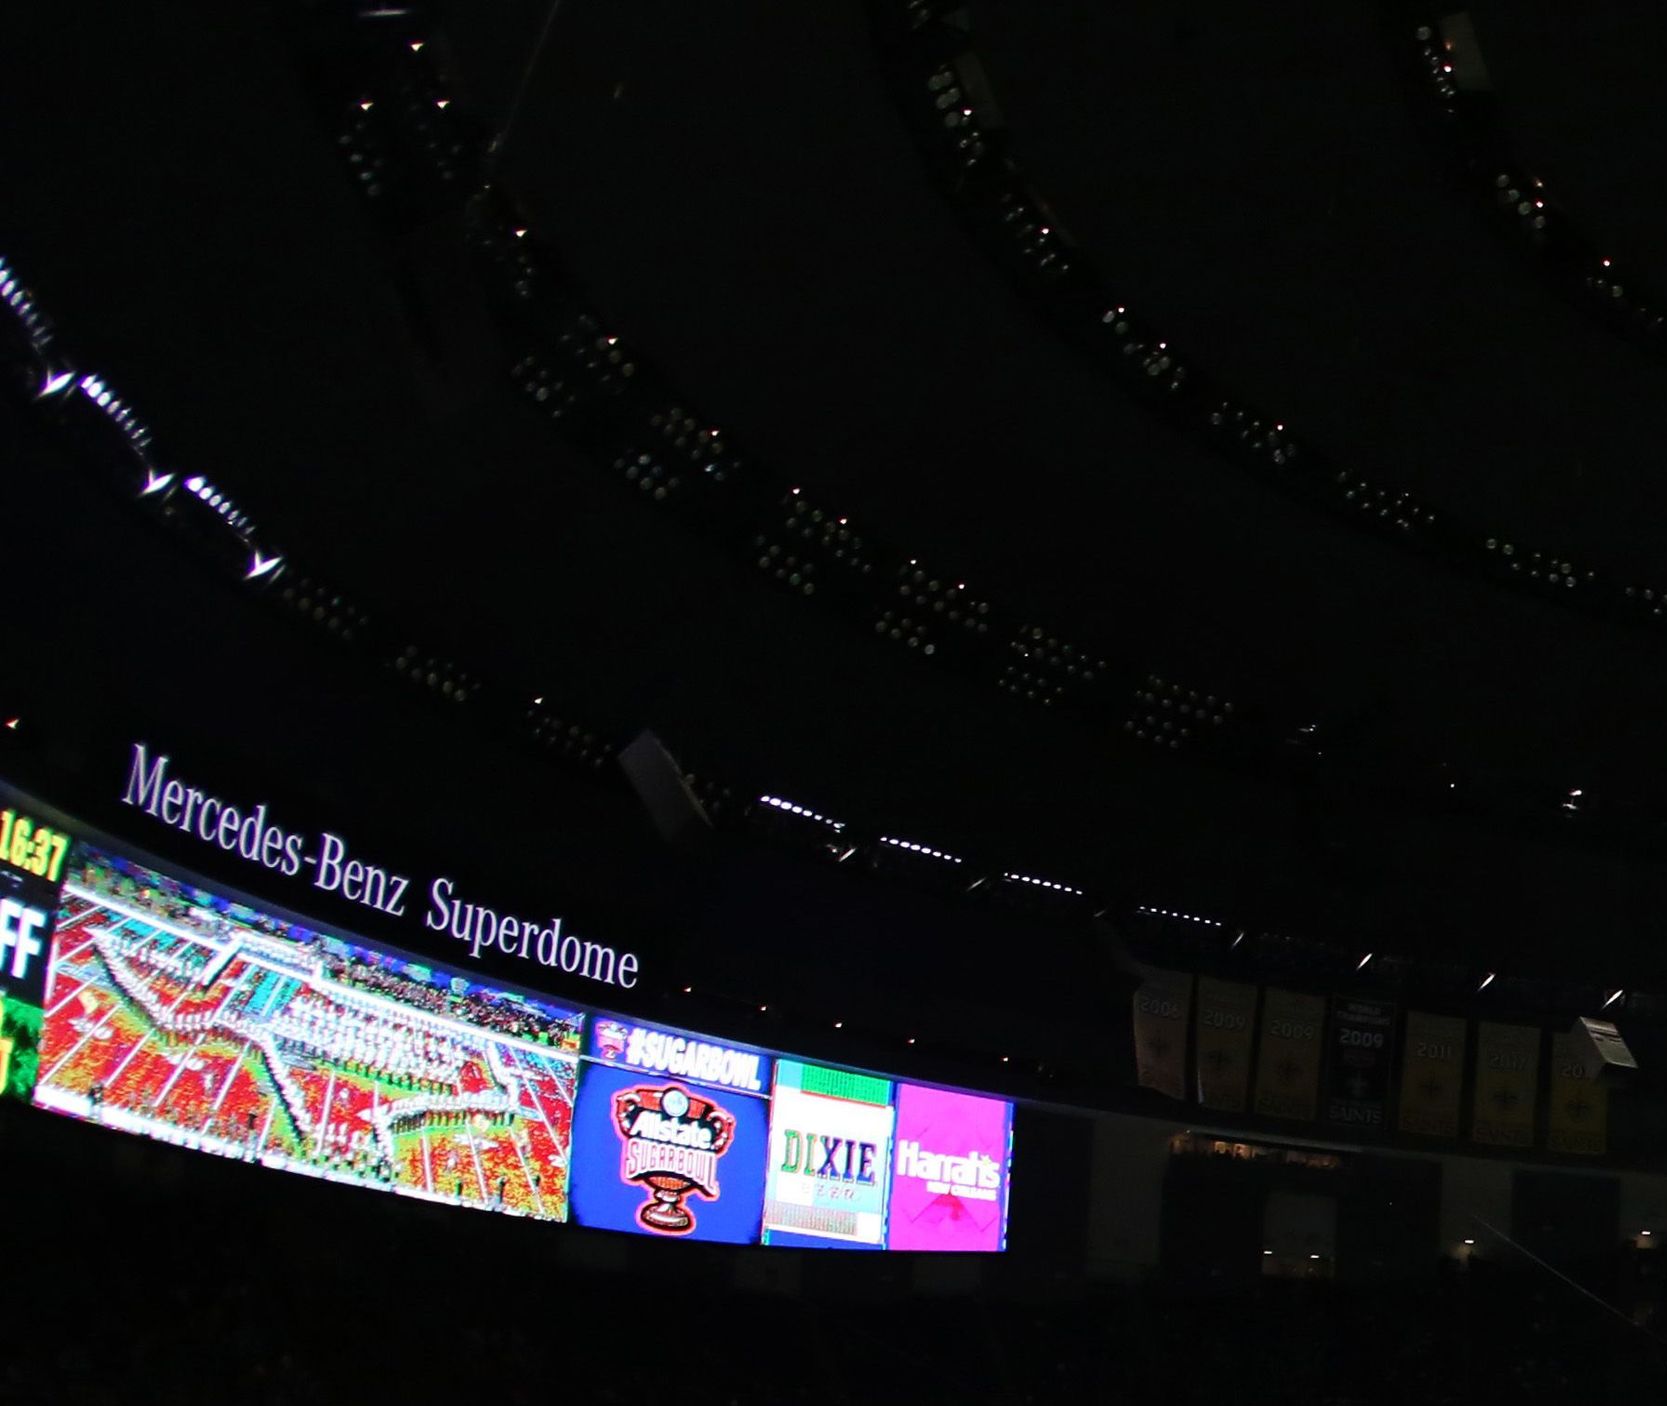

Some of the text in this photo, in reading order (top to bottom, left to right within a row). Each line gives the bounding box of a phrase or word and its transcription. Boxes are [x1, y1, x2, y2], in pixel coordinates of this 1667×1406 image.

[122, 743, 640, 989] Mercedes-Benz Superdome
[1339, 1028, 1384, 1048] 2009
[781, 1129, 878, 1184] DIXIE
